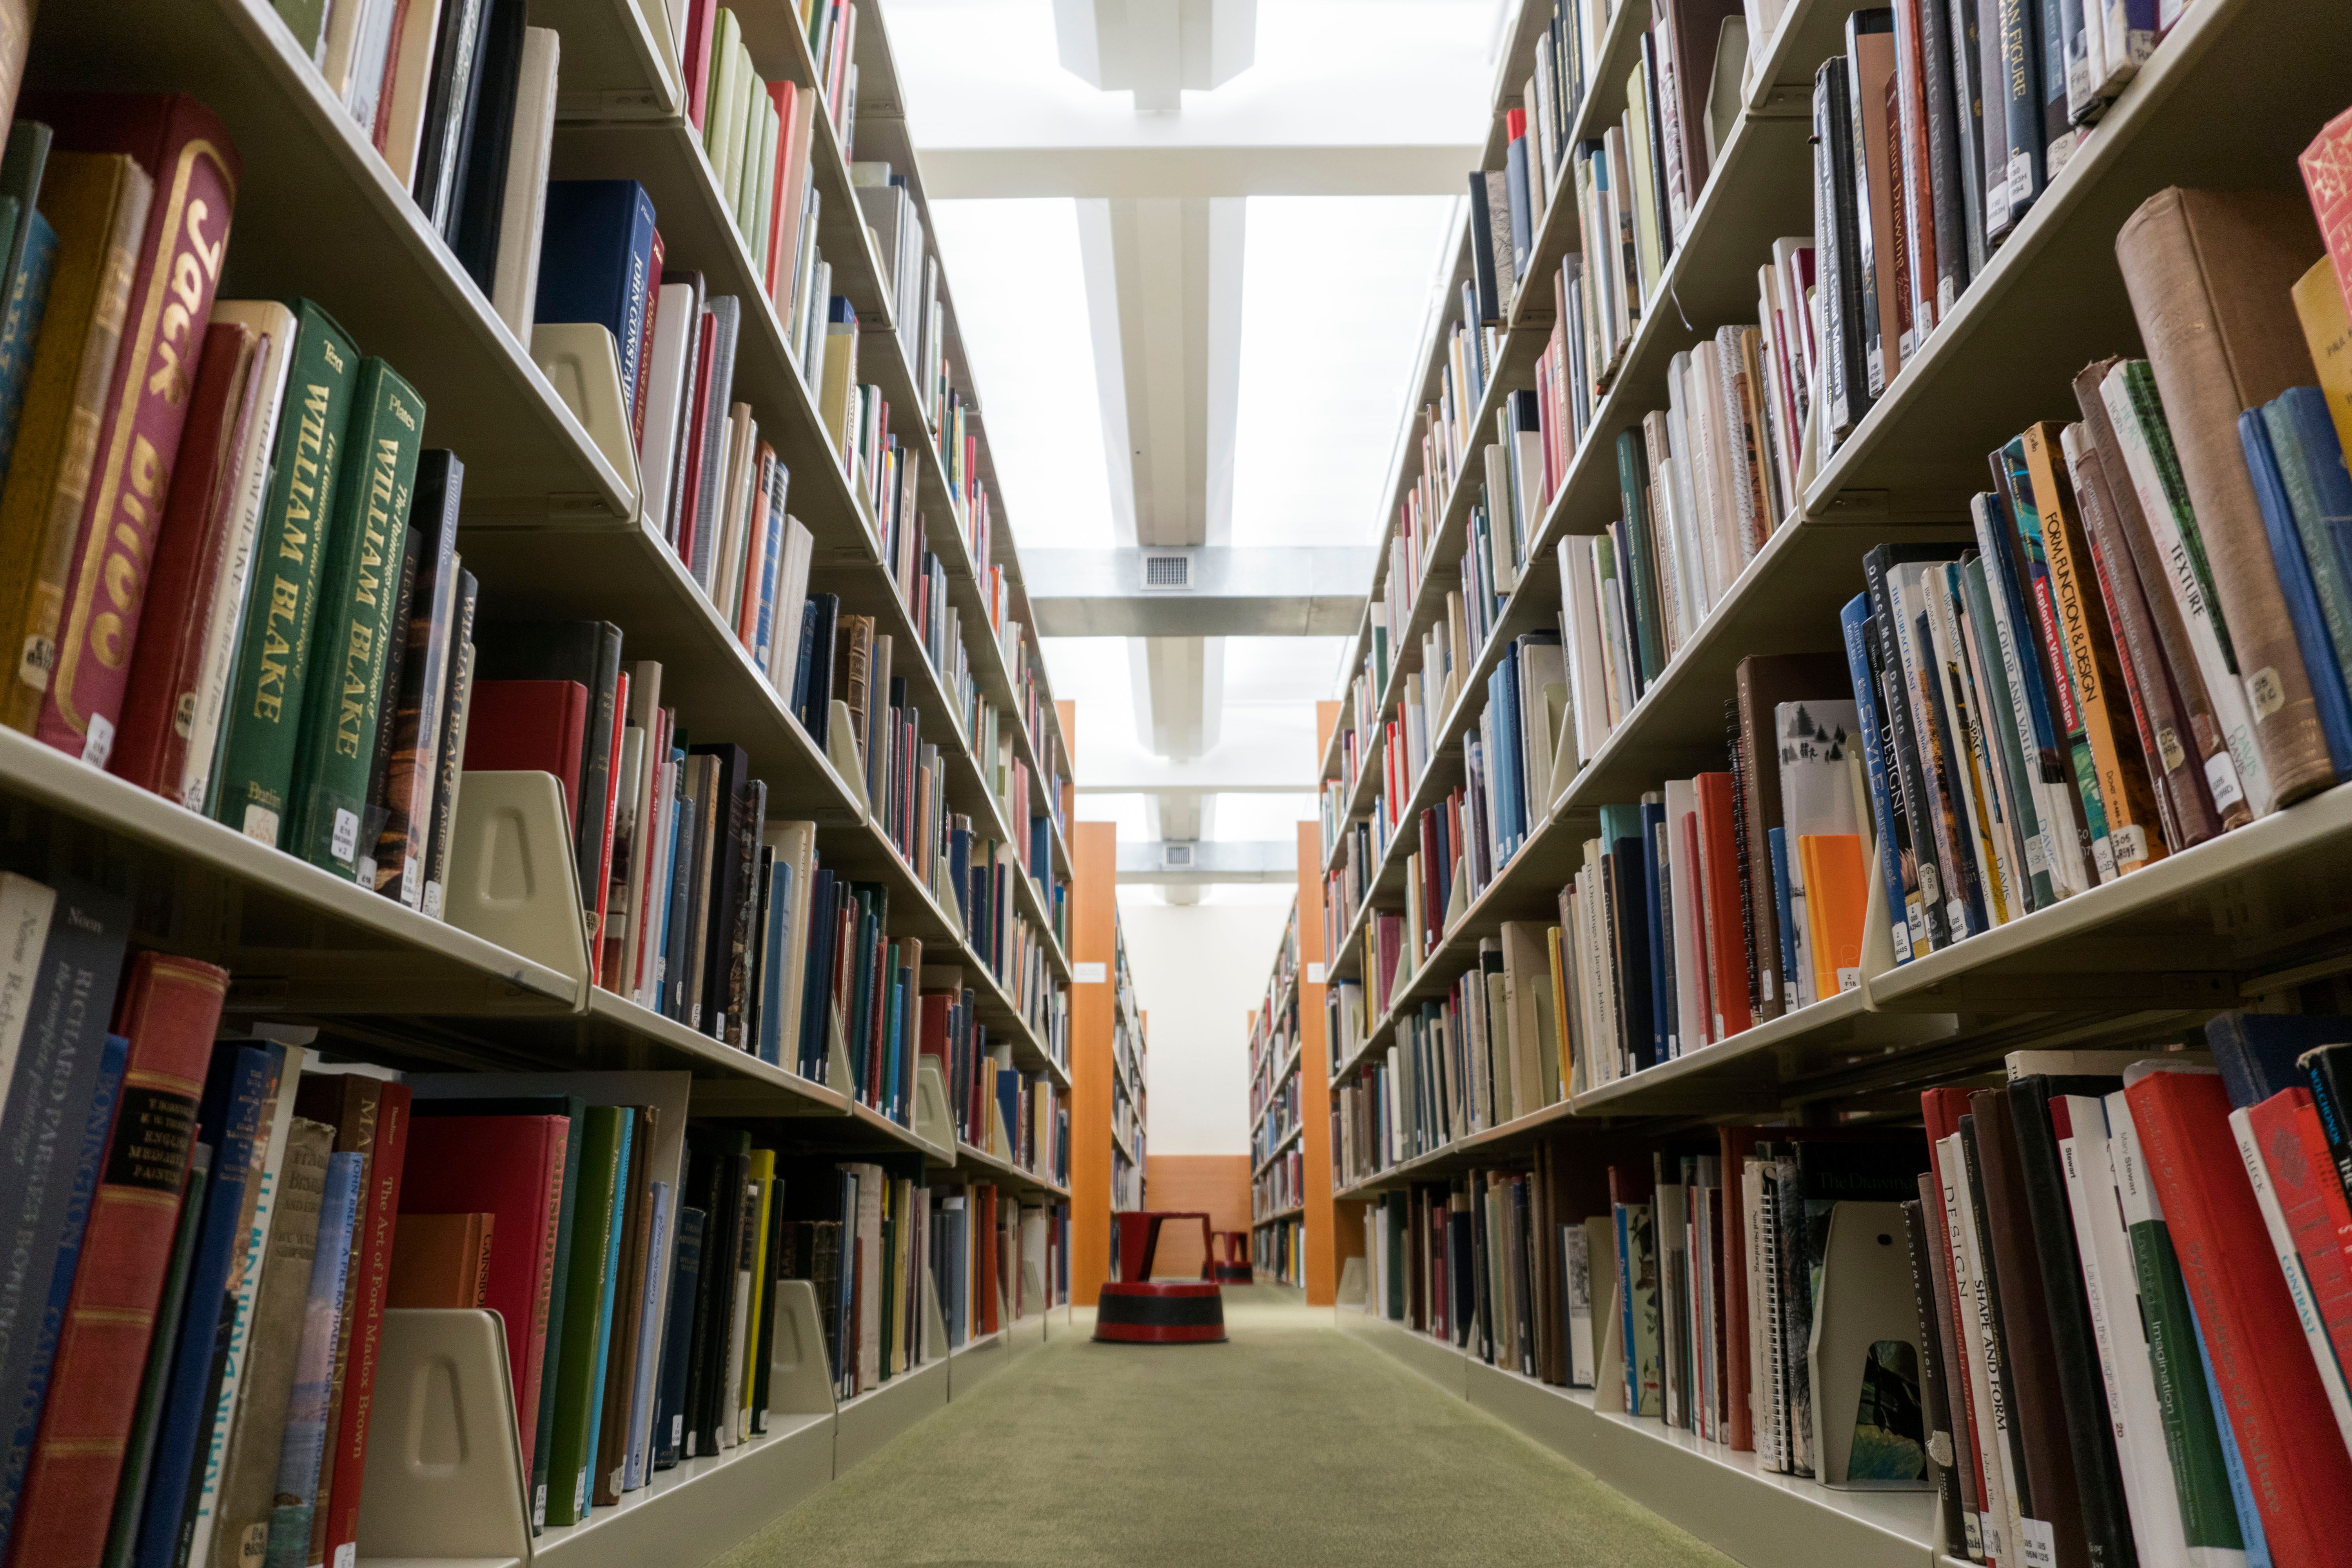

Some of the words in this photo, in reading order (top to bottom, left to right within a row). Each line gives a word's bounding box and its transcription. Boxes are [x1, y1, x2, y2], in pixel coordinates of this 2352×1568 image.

[2009, 27, 2026, 100] FIGURE
[1818, 101, 1829, 177] Anatomy
[1889, 119, 1898, 178] Figure
[1822, 181, 1834, 246] Lessons
[1888, 183, 1904, 270] Drawing
[150, 198, 221, 406] Jack
[628, 251, 643, 305] JOHN
[1828, 274, 1838, 320] Great
[644, 290, 655, 338] JOHN
[1830, 323, 1844, 396] Masters
[389, 393, 415, 431] Plates
[635, 341, 650, 438] CONSTABLE
[2120, 402, 2143, 450] HORN
[283, 385, 327, 562] WILLIAM
[394, 483, 408, 515] The
[446, 474, 458, 525] William
[2065, 454, 2082, 491] GATTO
[233, 507, 256, 586] BLAKE
[356, 438, 397, 606] WILLIAM
[442, 526, 454, 565] Blake
[1627, 515, 1632, 525] de
[1628, 526, 1636, 555] kooning
[2046, 512, 2062, 559] FORM,
[91, 434, 168, 670] Bilbo
[382, 515, 403, 588] Paintings
[227, 597, 239, 624] His
[379, 588, 392, 623] and
[2033, 583, 2056, 642] Exploring
[2057, 556, 2080, 630] FUNCTION
[2108, 401, 2125, 434] HORN
[2160, 548, 2173, 570] AND
[2167, 568, 2185, 603] UNITY
[2226, 733, 2245, 773] DAVIS
[216, 649, 228, 680] and
[222, 628, 233, 649] Art
[259, 574, 298, 720] BLAKE
[367, 622, 387, 699] Drawings
[452, 595, 474, 702] WILLIAM
[1847, 624, 1858, 664] MILLER
[1852, 620, 1864, 658] JUDITH
[1869, 564, 1885, 619] Direct
[1882, 626, 1893, 663] Mail
[1890, 671, 1906, 734] Design
[2048, 642, 2065, 682] Visual
[2073, 634, 2085, 646] &
[2172, 543, 2202, 616] TEXTURE
[2232, 723, 2260, 776] DAVIS
[205, 681, 221, 723] Times
[334, 619, 371, 758] BLAKE
[1874, 669, 1884, 696] Aimone
[1975, 532, 1991, 583] GATTO
[1996, 621, 2013, 671] COLOR
[2009, 681, 2024, 713] AND
[2039, 819, 2055, 867] DAVIS
[2075, 646, 2097, 702] DESIGN
[1897, 609, 1908, 655] SURFACE
[1904, 657, 1915, 690] PLANE
[1934, 808, 1944, 848] Newman
[2056, 683, 2076, 727] Design
[441, 707, 460, 794] BLAKE
[1859, 705, 1885, 794] STYLE
[1882, 724, 1906, 813] DESIGN!
[1924, 587, 1936, 632] BROMMER
[1979, 869, 1988, 900] DAVIS
[1944, 593, 1961, 659] BROMMER
[1969, 719, 1981, 760] SPACE
[1996, 858, 2008, 902] DAVIS
[1594, 942, 1599, 952] of
[53, 970, 90, 1100] RICHARD
[609, 1148, 619, 1195] Thomas
[2120, 1132, 2130, 1154] Mary
[2243, 1141, 2264, 1192] SELLECK
[348, 1158, 361, 1194] JOHN
[381, 1176, 392, 1210] The
[2124, 1157, 2138, 1195] Stewart
[342, 1247, 350, 1257] A
[376, 1216, 387, 1246] Art
[534, 1136, 568, 1333] Gainsborough
[600, 1199, 612, 1284] Gainsborough
[648, 1215, 663, 1304] Gainsborough
[1752, 1231, 1761, 1272] Steinberg
[1945, 1186, 1967, 1298] DESIGN
[369, 1275, 381, 1317] Ford
[1905, 1210, 1919, 1289] PROBLEMS
[1917, 1296, 1923, 1314] OF
[1920, 1321, 1931, 1378] DESIGN
[1976, 1279, 1992, 1329] SHAPE
[2064, 1147, 2075, 1178] Stewart
[2082, 1264, 2103, 1322] Launching
[2097, 1325, 2107, 1343] the
[2103, 1347, 2121, 1413] Imagination
[2282, 1256, 2315, 1333] CONTRAST
[328, 1261, 347, 1365] PRE-RAPHAELITE
[1784, 1302, 1792, 1338] drawing
[325, 1371, 332, 1391] ON
[360, 1323, 376, 1387] Madox
[1985, 1336, 1998, 1373] AND
[2153, 1320, 2178, 1414] Imagination
[2190, 1241, 2239, 1378] Symmetries
[2245, 1416, 2283, 1512] Culture
[320, 1397, 329, 1421] THE
[354, 1395, 368, 1458] Brown
[1989, 1379, 2008, 1430] FORM
